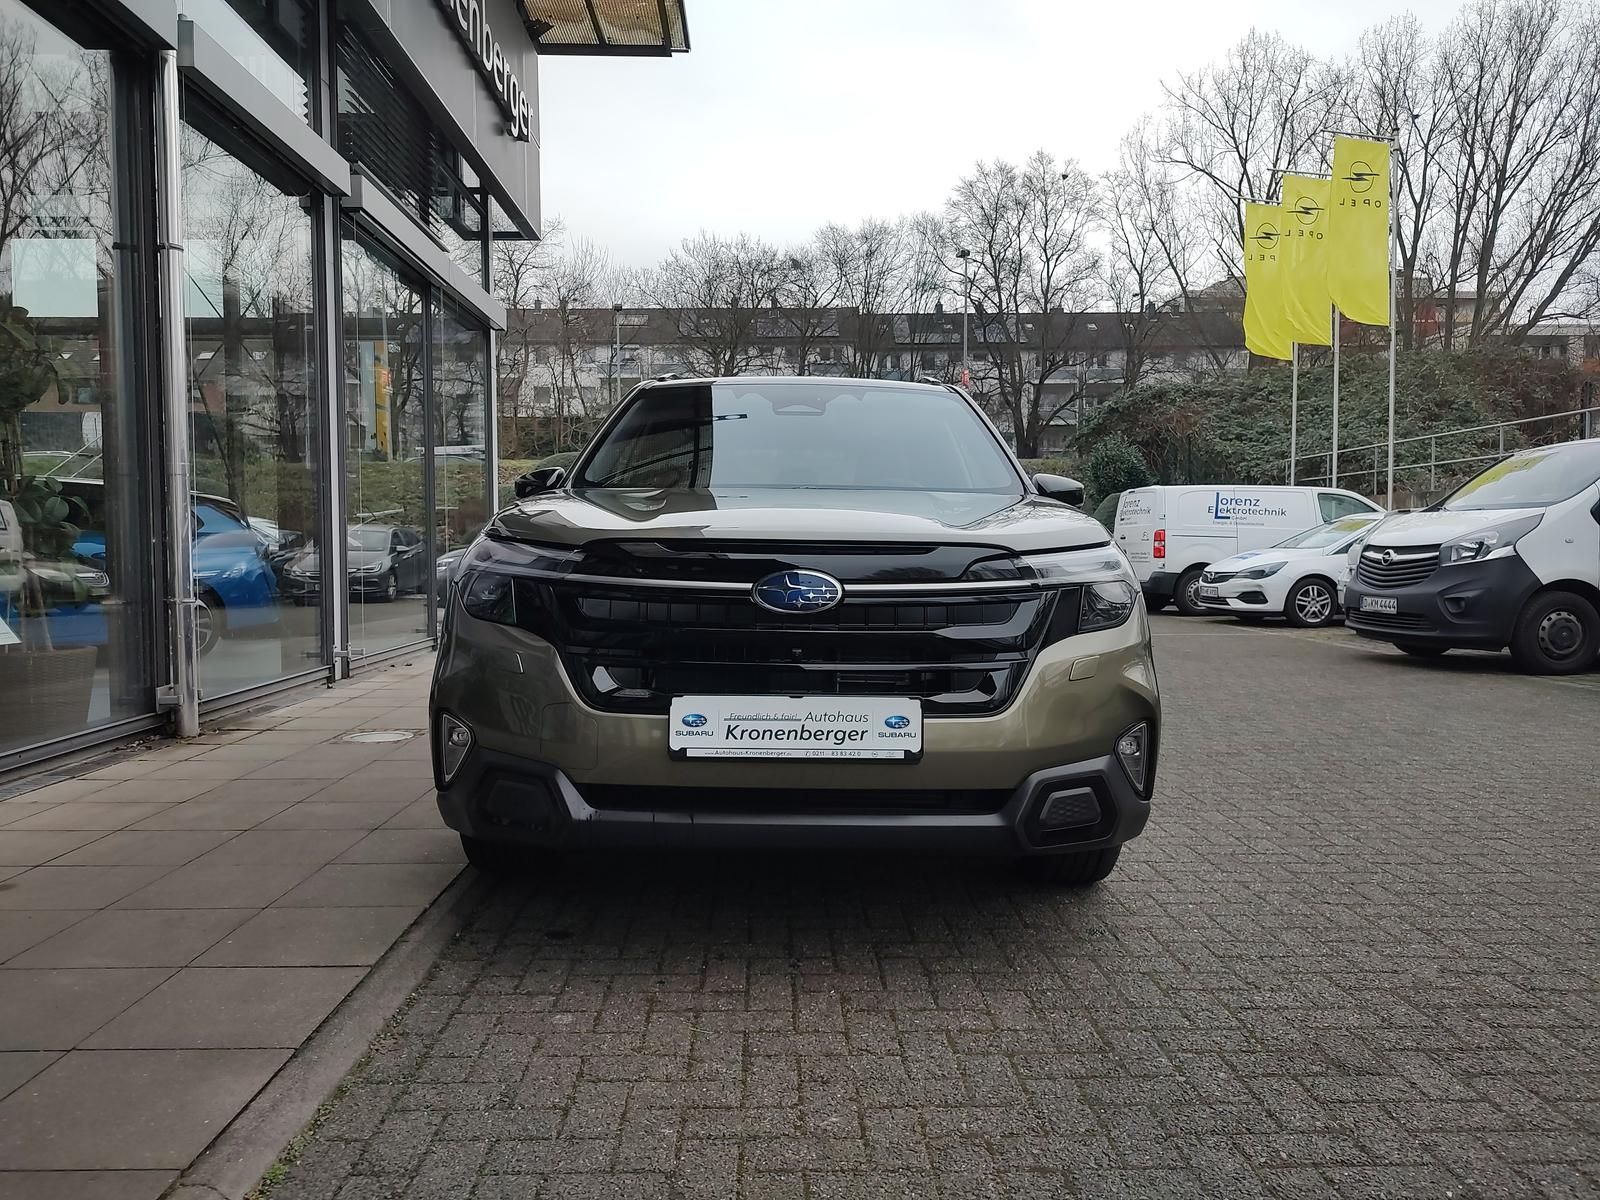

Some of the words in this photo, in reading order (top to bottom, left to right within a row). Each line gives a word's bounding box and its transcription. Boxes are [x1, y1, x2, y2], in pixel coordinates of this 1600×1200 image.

[450, 0, 534, 142] enberger
[1214, 492, 1260, 519] Lorenz
[1379, 599, 1396, 610] 4444
[729, 712, 771, 721] Freundlich
[780, 712, 798, 721] fair!
[803, 711, 869, 723] Autohaus
[725, 724, 869, 746] Kronenberger
